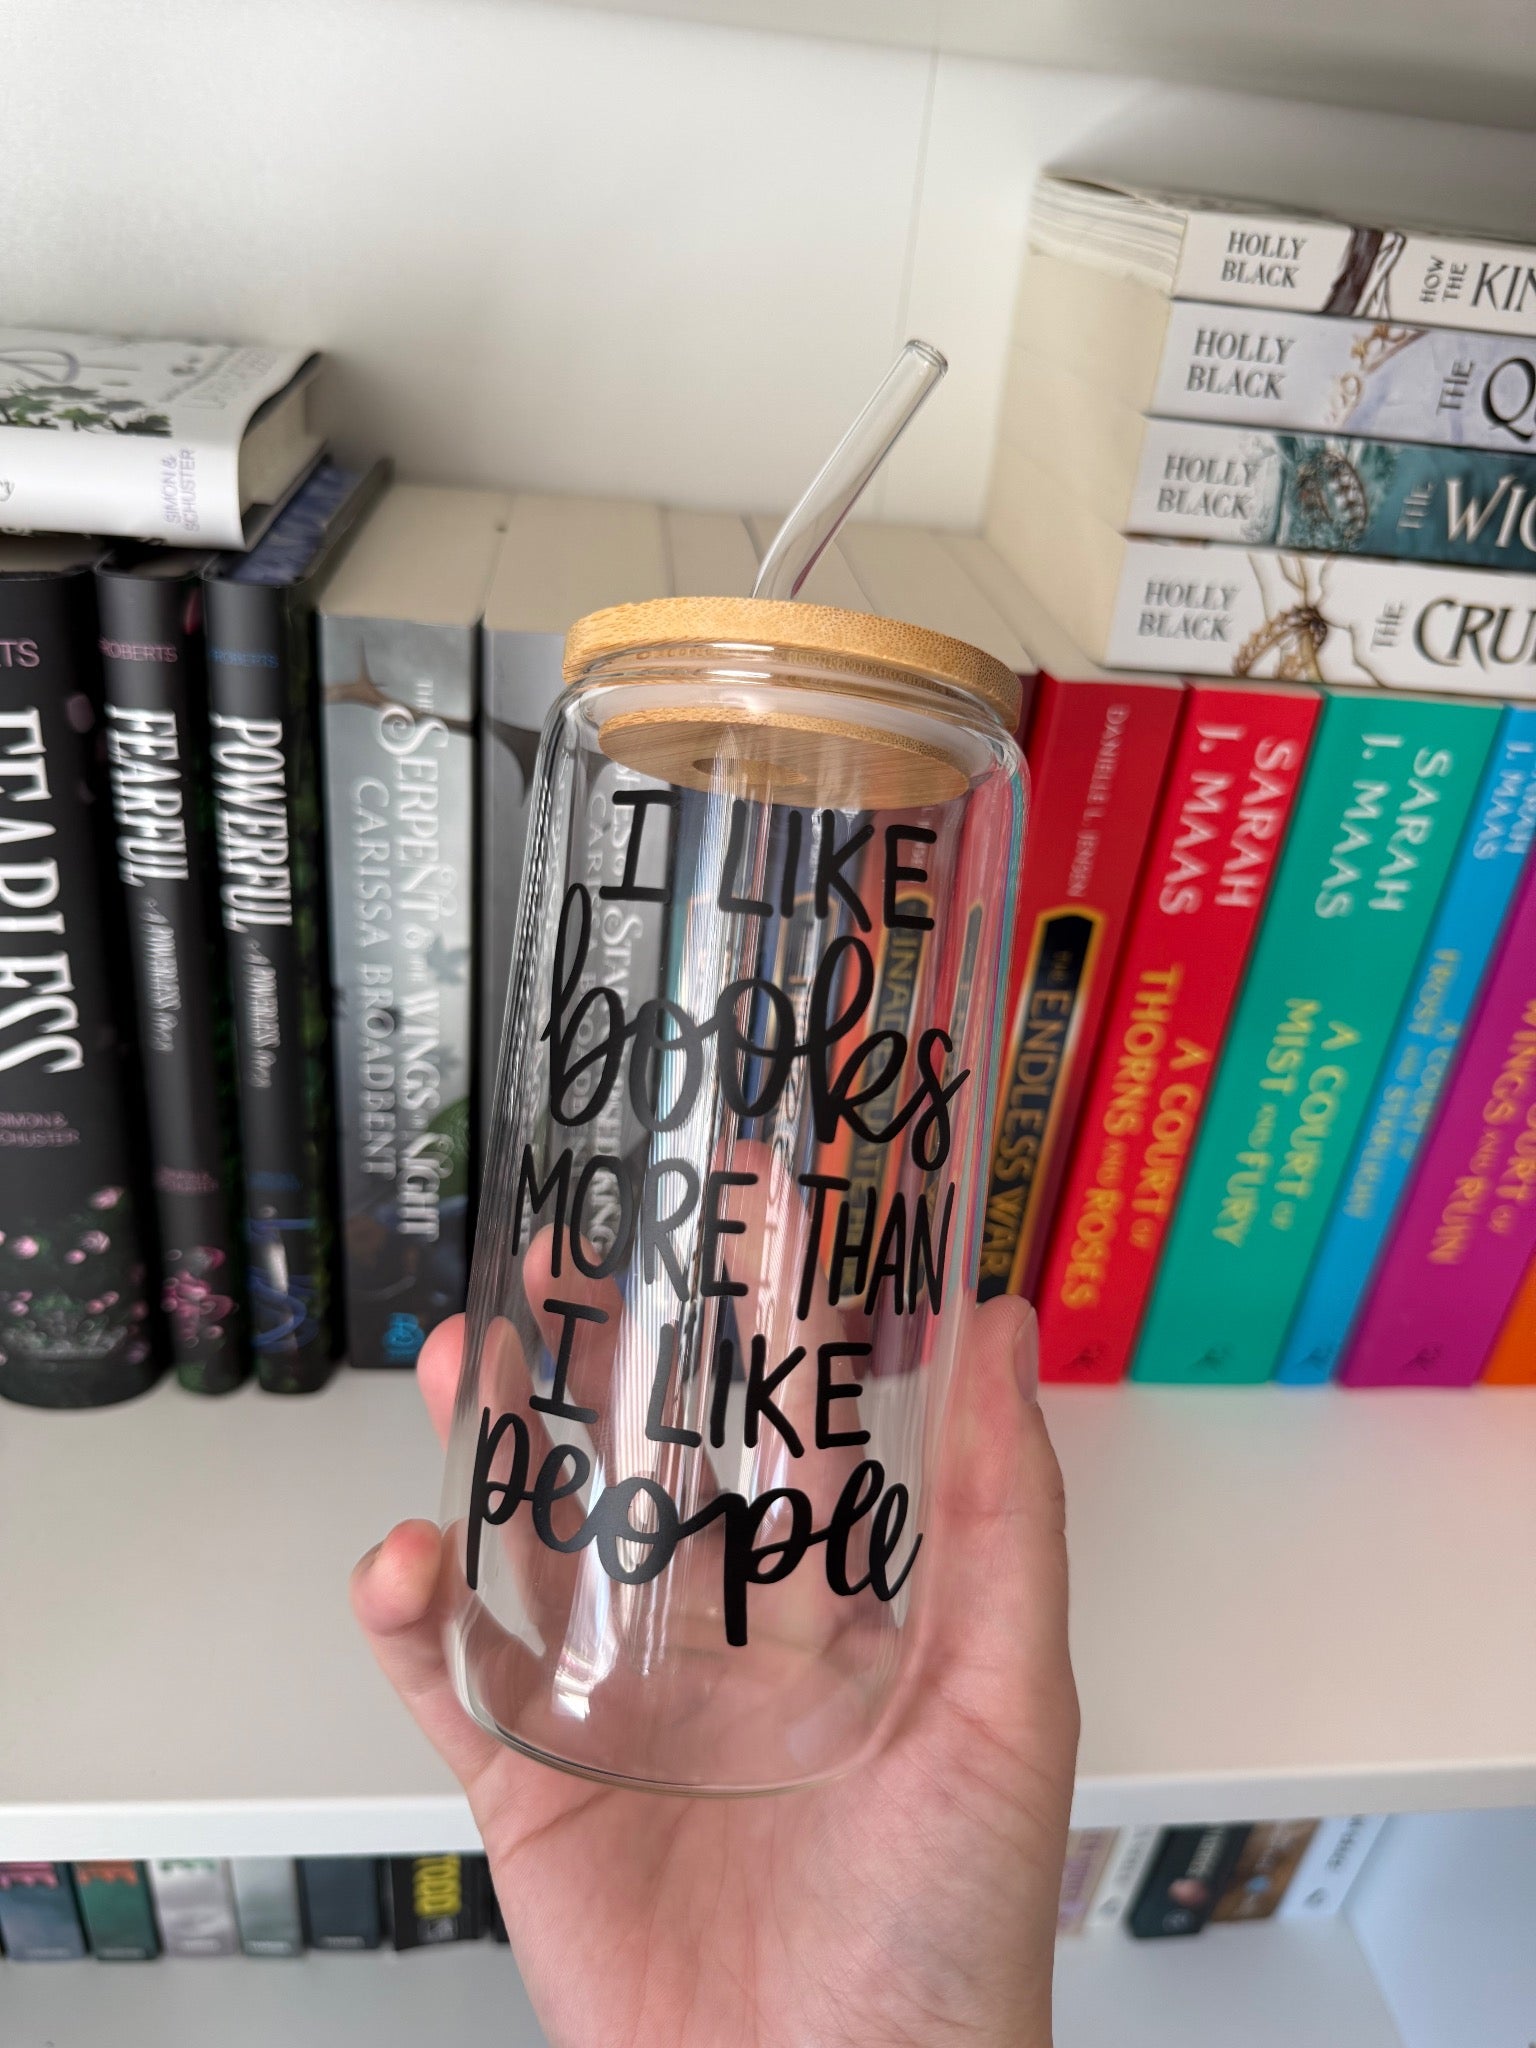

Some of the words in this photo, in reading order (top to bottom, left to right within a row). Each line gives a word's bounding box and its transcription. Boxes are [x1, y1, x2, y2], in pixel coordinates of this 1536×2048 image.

[1221, 259, 1300, 288] BLACK
[1228, 231, 1306, 260] HOLLY
[1419, 256, 1444, 303] HOW
[1442, 262, 1468, 302] THE
[1186, 364, 1286, 399] BLACK
[1193, 328, 1295, 364] HOLLY
[1437, 360, 1476, 414] THE
[161, 472, 181, 524] SIMON
[178, 449, 200, 532] SCHUSTER
[1157, 488, 1251, 520] BLACK
[1164, 455, 1261, 487] HOLLY
[1398, 482, 1434, 530] THE
[1138, 612, 1232, 642] BLACK
[1145, 582, 1239, 611] HOLLY
[104, 704, 189, 888] FEARFUL
[209, 713, 293, 934] POWERFUL
[379, 704, 457, 922] SERPENT
[1158, 770, 1235, 916] MAAS
[1214, 735, 1301, 909] SARAH
[1314, 778, 1389, 919] MAAS
[1367, 744, 1455, 912] SARAH
[1472, 768, 1525, 860] MAAS
[353, 777, 392, 948] CARISSA
[599, 790, 681, 903] I
[717, 799, 938, 932] LIKE
[359, 962, 396, 1181] BROADBENT
[400, 990, 441, 1112] WINGS
[540, 883, 971, 1171] books
[1103, 962, 1182, 1137] THORNS
[1174, 1038, 1212, 1071] A
[1260, 997, 1322, 1096] MIST
[1320, 1020, 1362, 1051] A
[992, 988, 1072, 1184] ENDLESS
[1276, 1063, 1348, 1198] COURT
[399, 1132, 453, 1242] NIGHT
[1138, 1084, 1199, 1217] COURT
[1212, 1150, 1273, 1250] FURY
[512, 1144, 759, 1301] MORE
[797, 1182, 955, 1321] THAN
[1060, 1185, 1118, 1310] ROSES
[529, 1299, 609, 1424] I
[645, 1322, 873, 1458] LIKE
[466, 1406, 924, 1647] people
